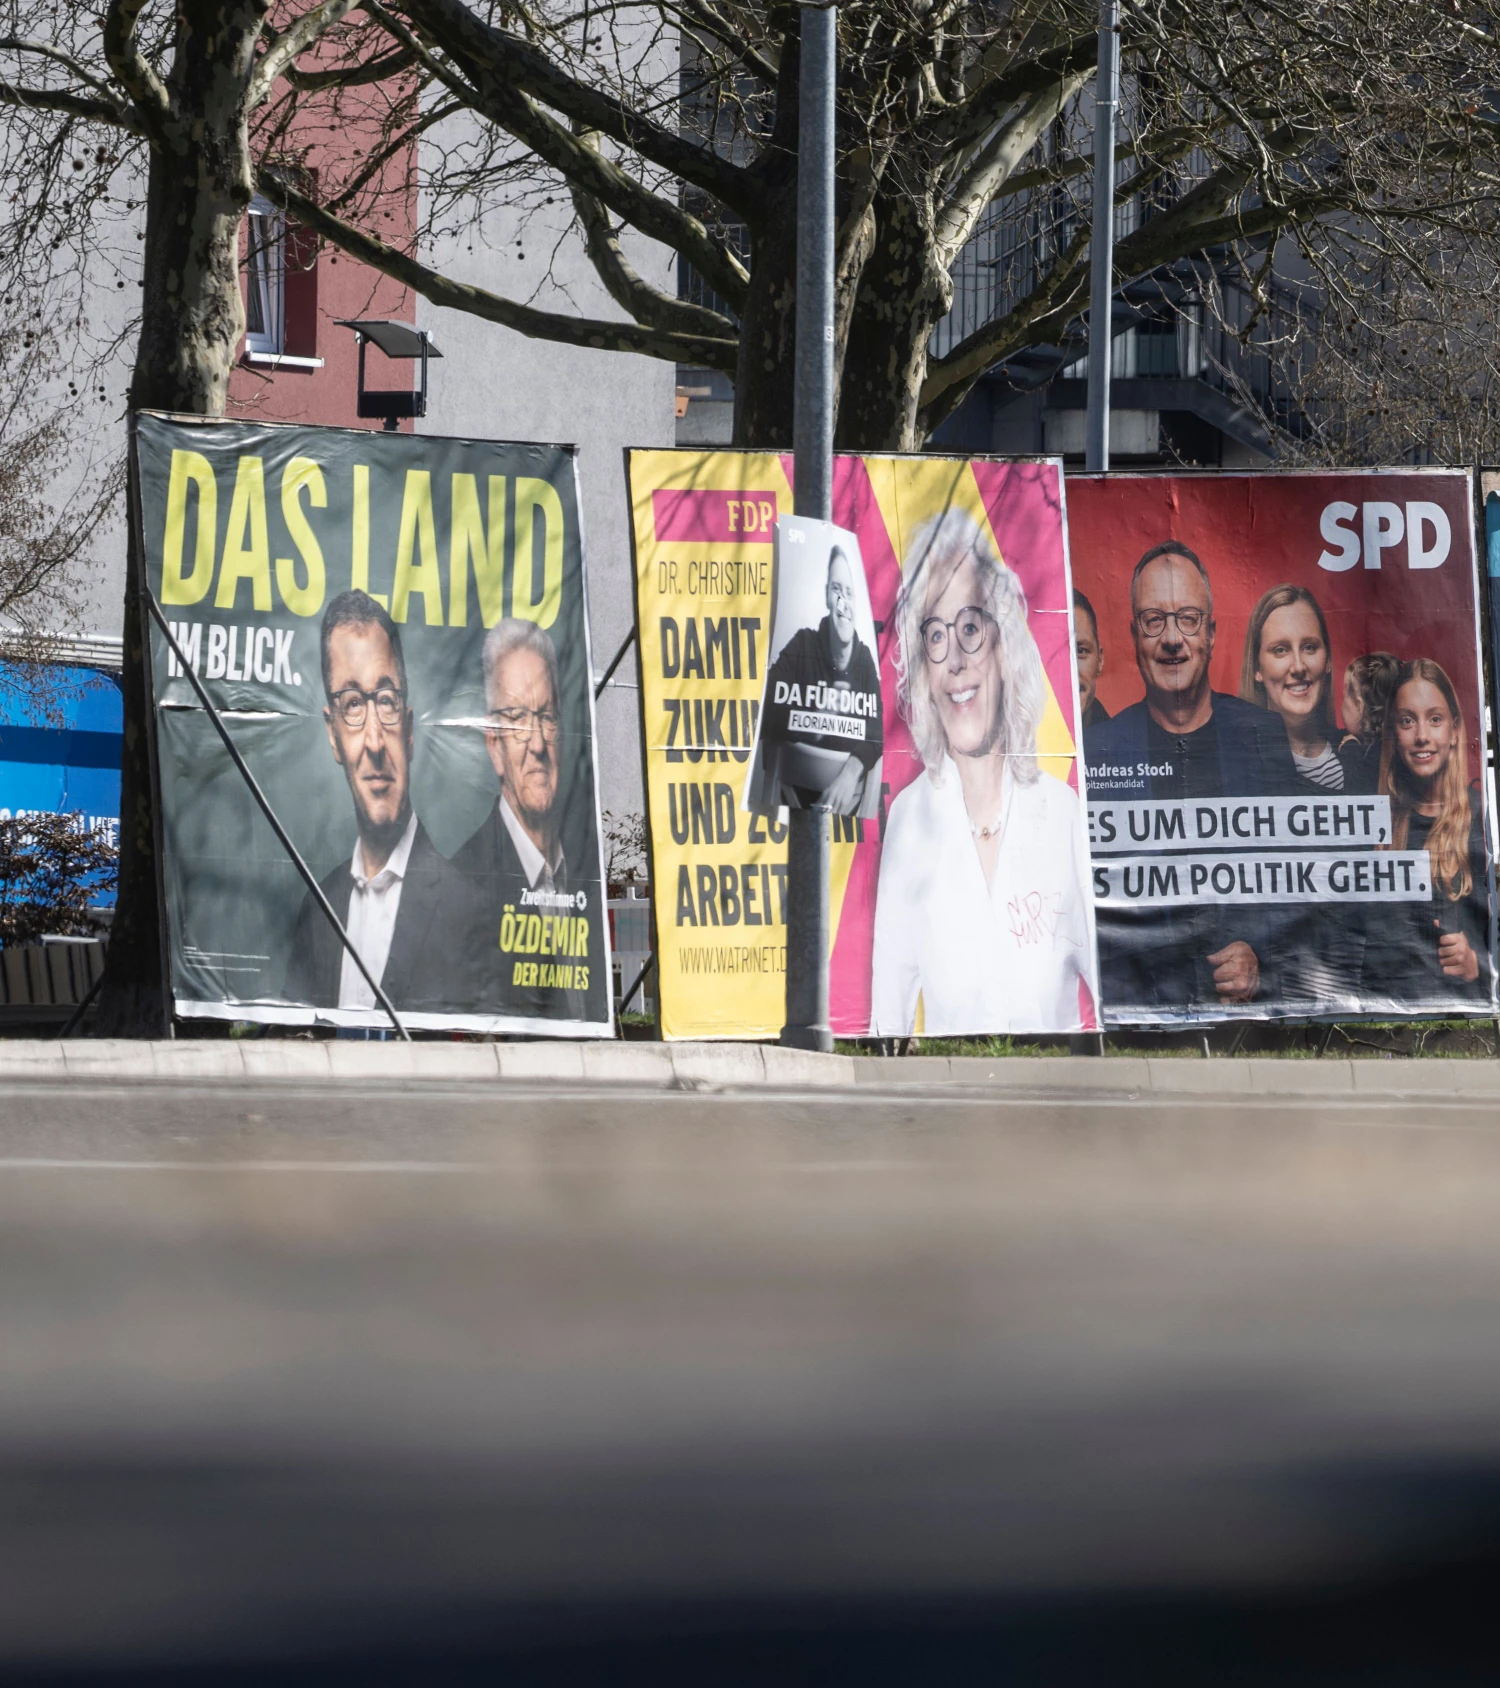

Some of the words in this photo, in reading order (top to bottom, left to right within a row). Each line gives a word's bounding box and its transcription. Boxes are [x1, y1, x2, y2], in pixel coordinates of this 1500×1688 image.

[726, 500, 773, 533] FDP
[787, 527, 806, 544] SPD
[161, 449, 328, 617] DAS
[350, 464, 565, 630] LAND
[1317, 501, 1452, 572] SPD
[658, 560, 682, 595] DR.
[687, 560, 768, 596] CHRISTINE
[167, 621, 203, 678] IM
[205, 624, 302, 687] BLICK.
[659, 616, 761, 680] DAMIT
[774, 681, 803, 707] DA
[805, 680, 839, 711] FÜR
[840, 689, 878, 718] DICH!
[791, 714, 836, 733] FLORIAN
[837, 720, 863, 737] WAHL
[1084, 763, 1134, 778] Andreas
[1136, 761, 1174, 777] Stoch
[668, 782, 736, 846] UND
[1127, 807, 1187, 842] UM
[1195, 805, 1276, 839] DICH
[1287, 804, 1387, 843] GEHT,
[1123, 864, 1181, 898] UM
[1190, 861, 1318, 895] POLITIK
[1327, 859, 1426, 893] GEHT.
[499, 903, 589, 957] ÖZDEMIR
[512, 961, 539, 987] DER
[538, 963, 573, 988] KANN
[573, 965, 589, 990] ES
